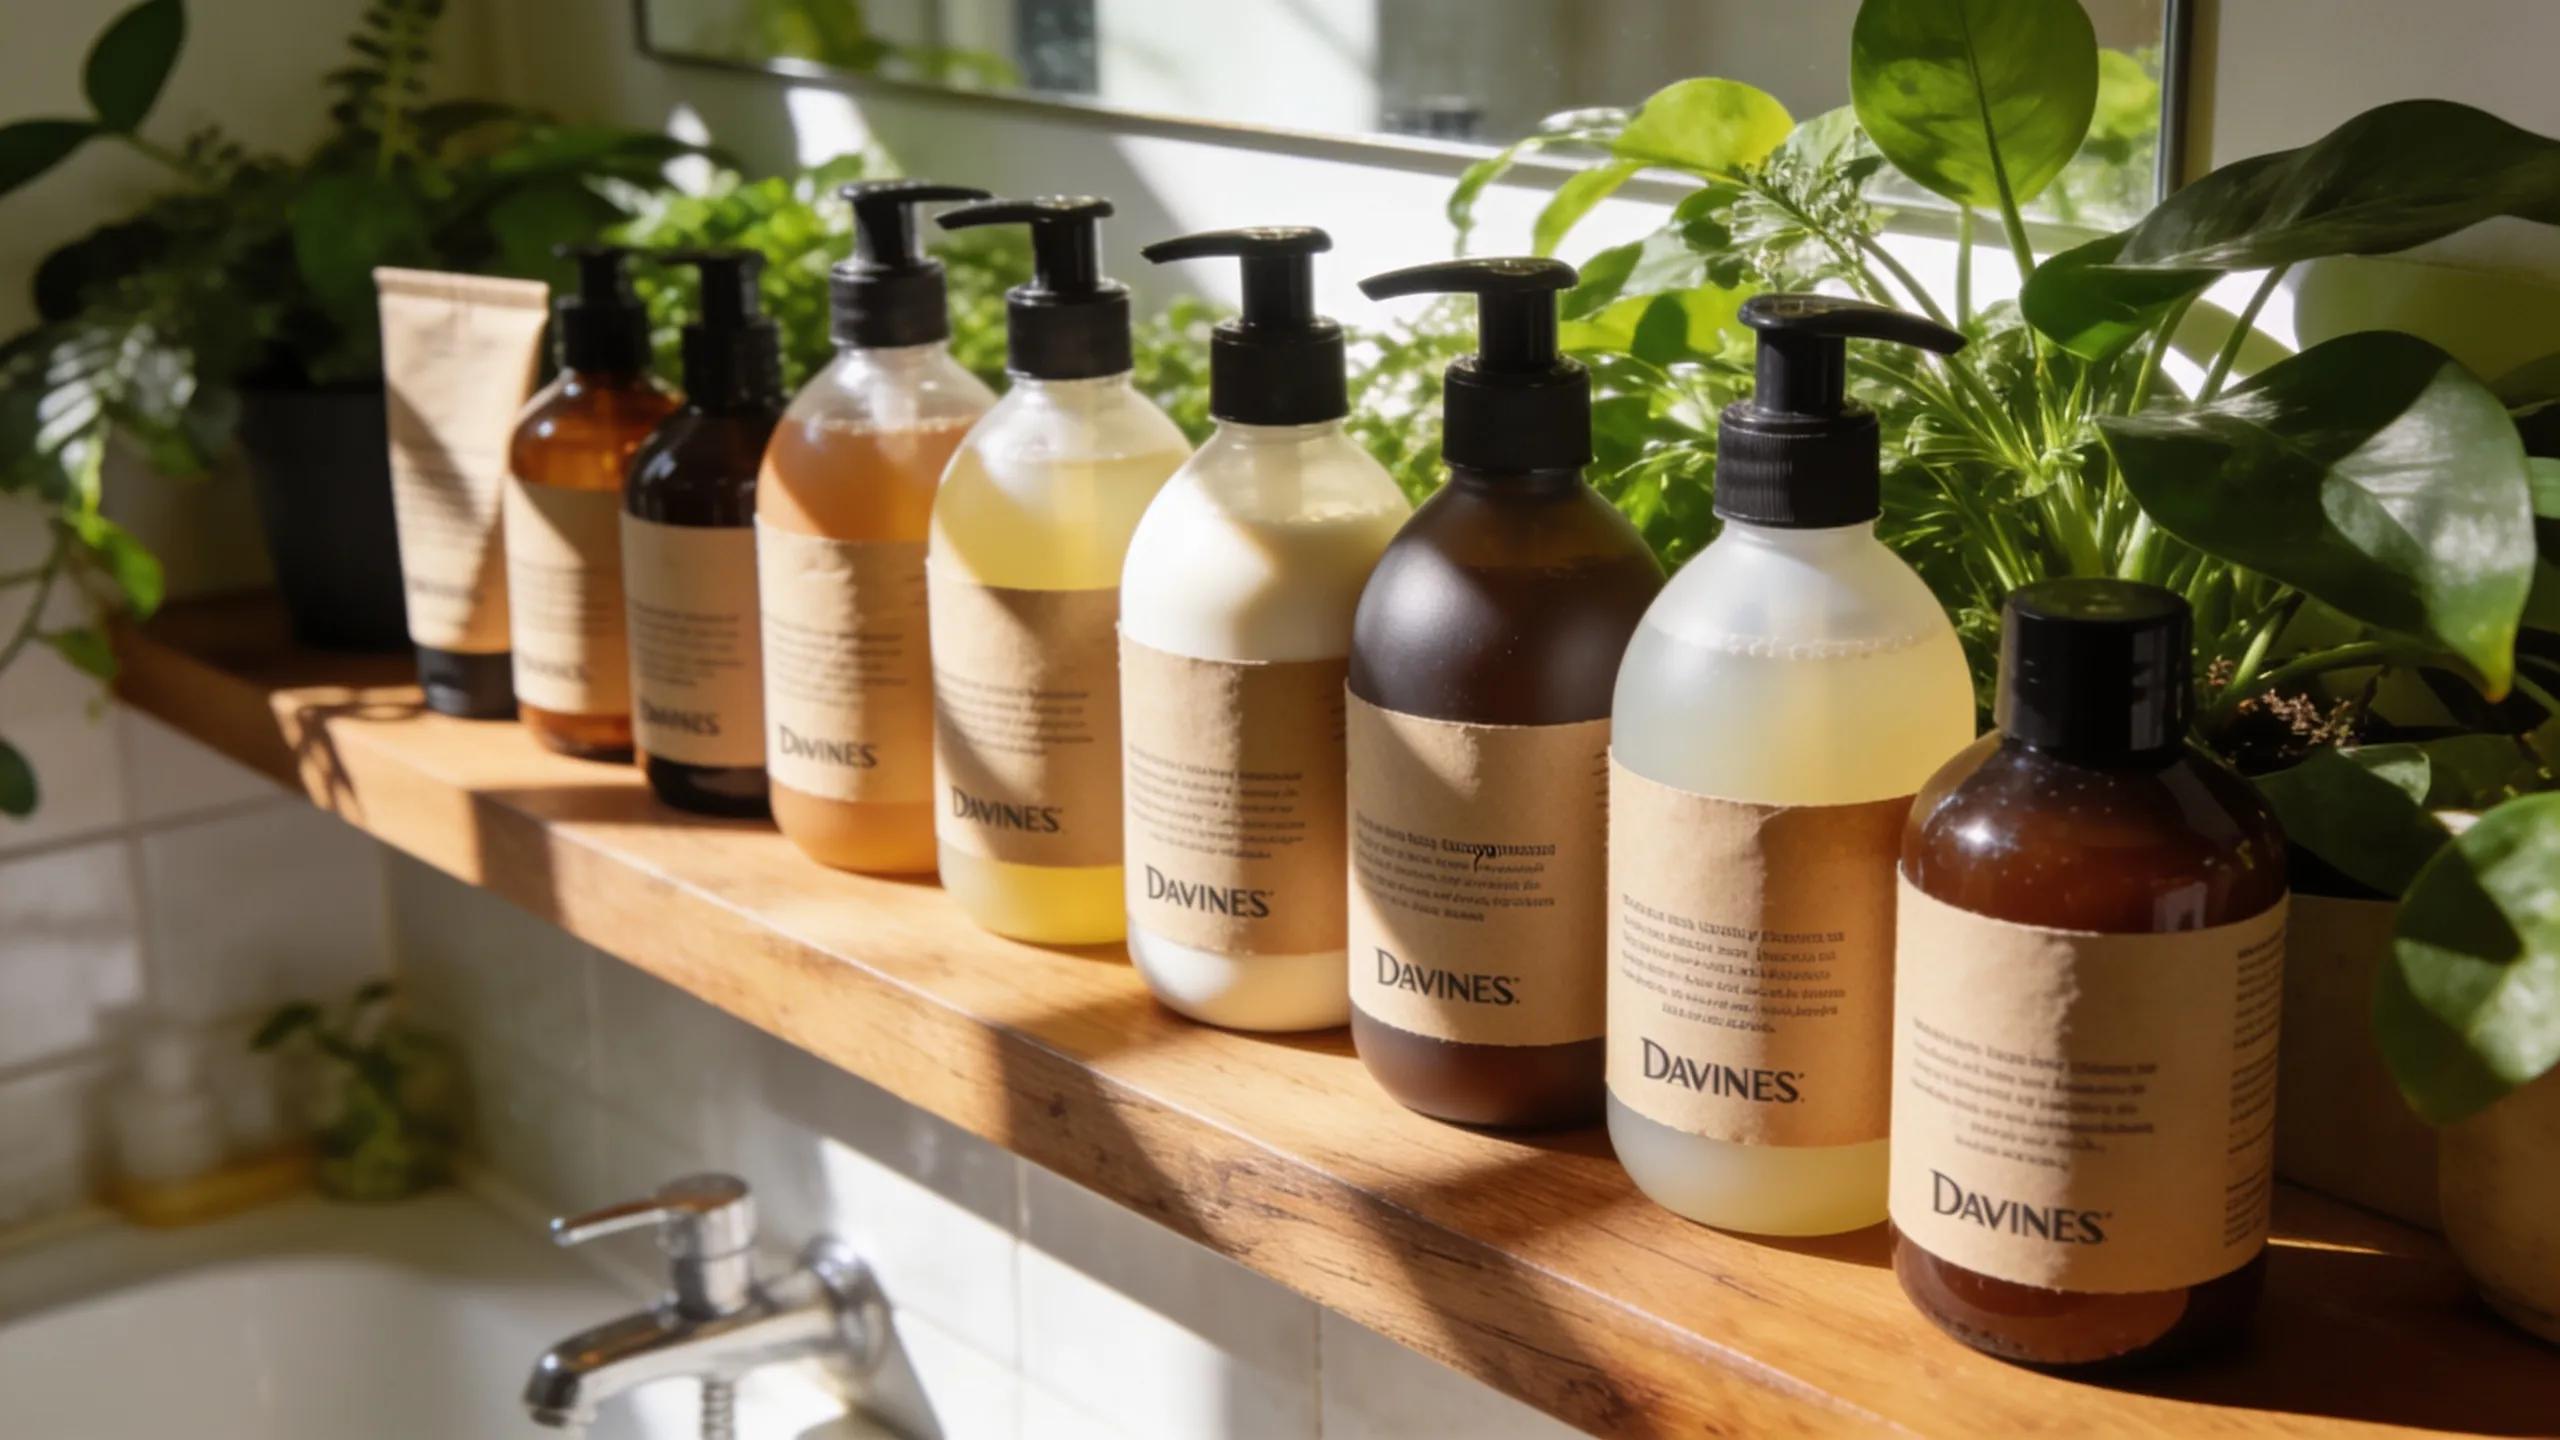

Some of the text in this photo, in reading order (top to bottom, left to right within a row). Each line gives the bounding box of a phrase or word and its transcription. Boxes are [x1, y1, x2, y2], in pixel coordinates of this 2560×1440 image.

[951, 785, 1060, 833] DAVINES
[1145, 864, 1270, 918] DAVINES
[1374, 946, 1517, 1006] DAVINES
[1640, 1036, 1800, 1104] DAVINES
[1930, 1168, 2107, 1245] DAVINES
